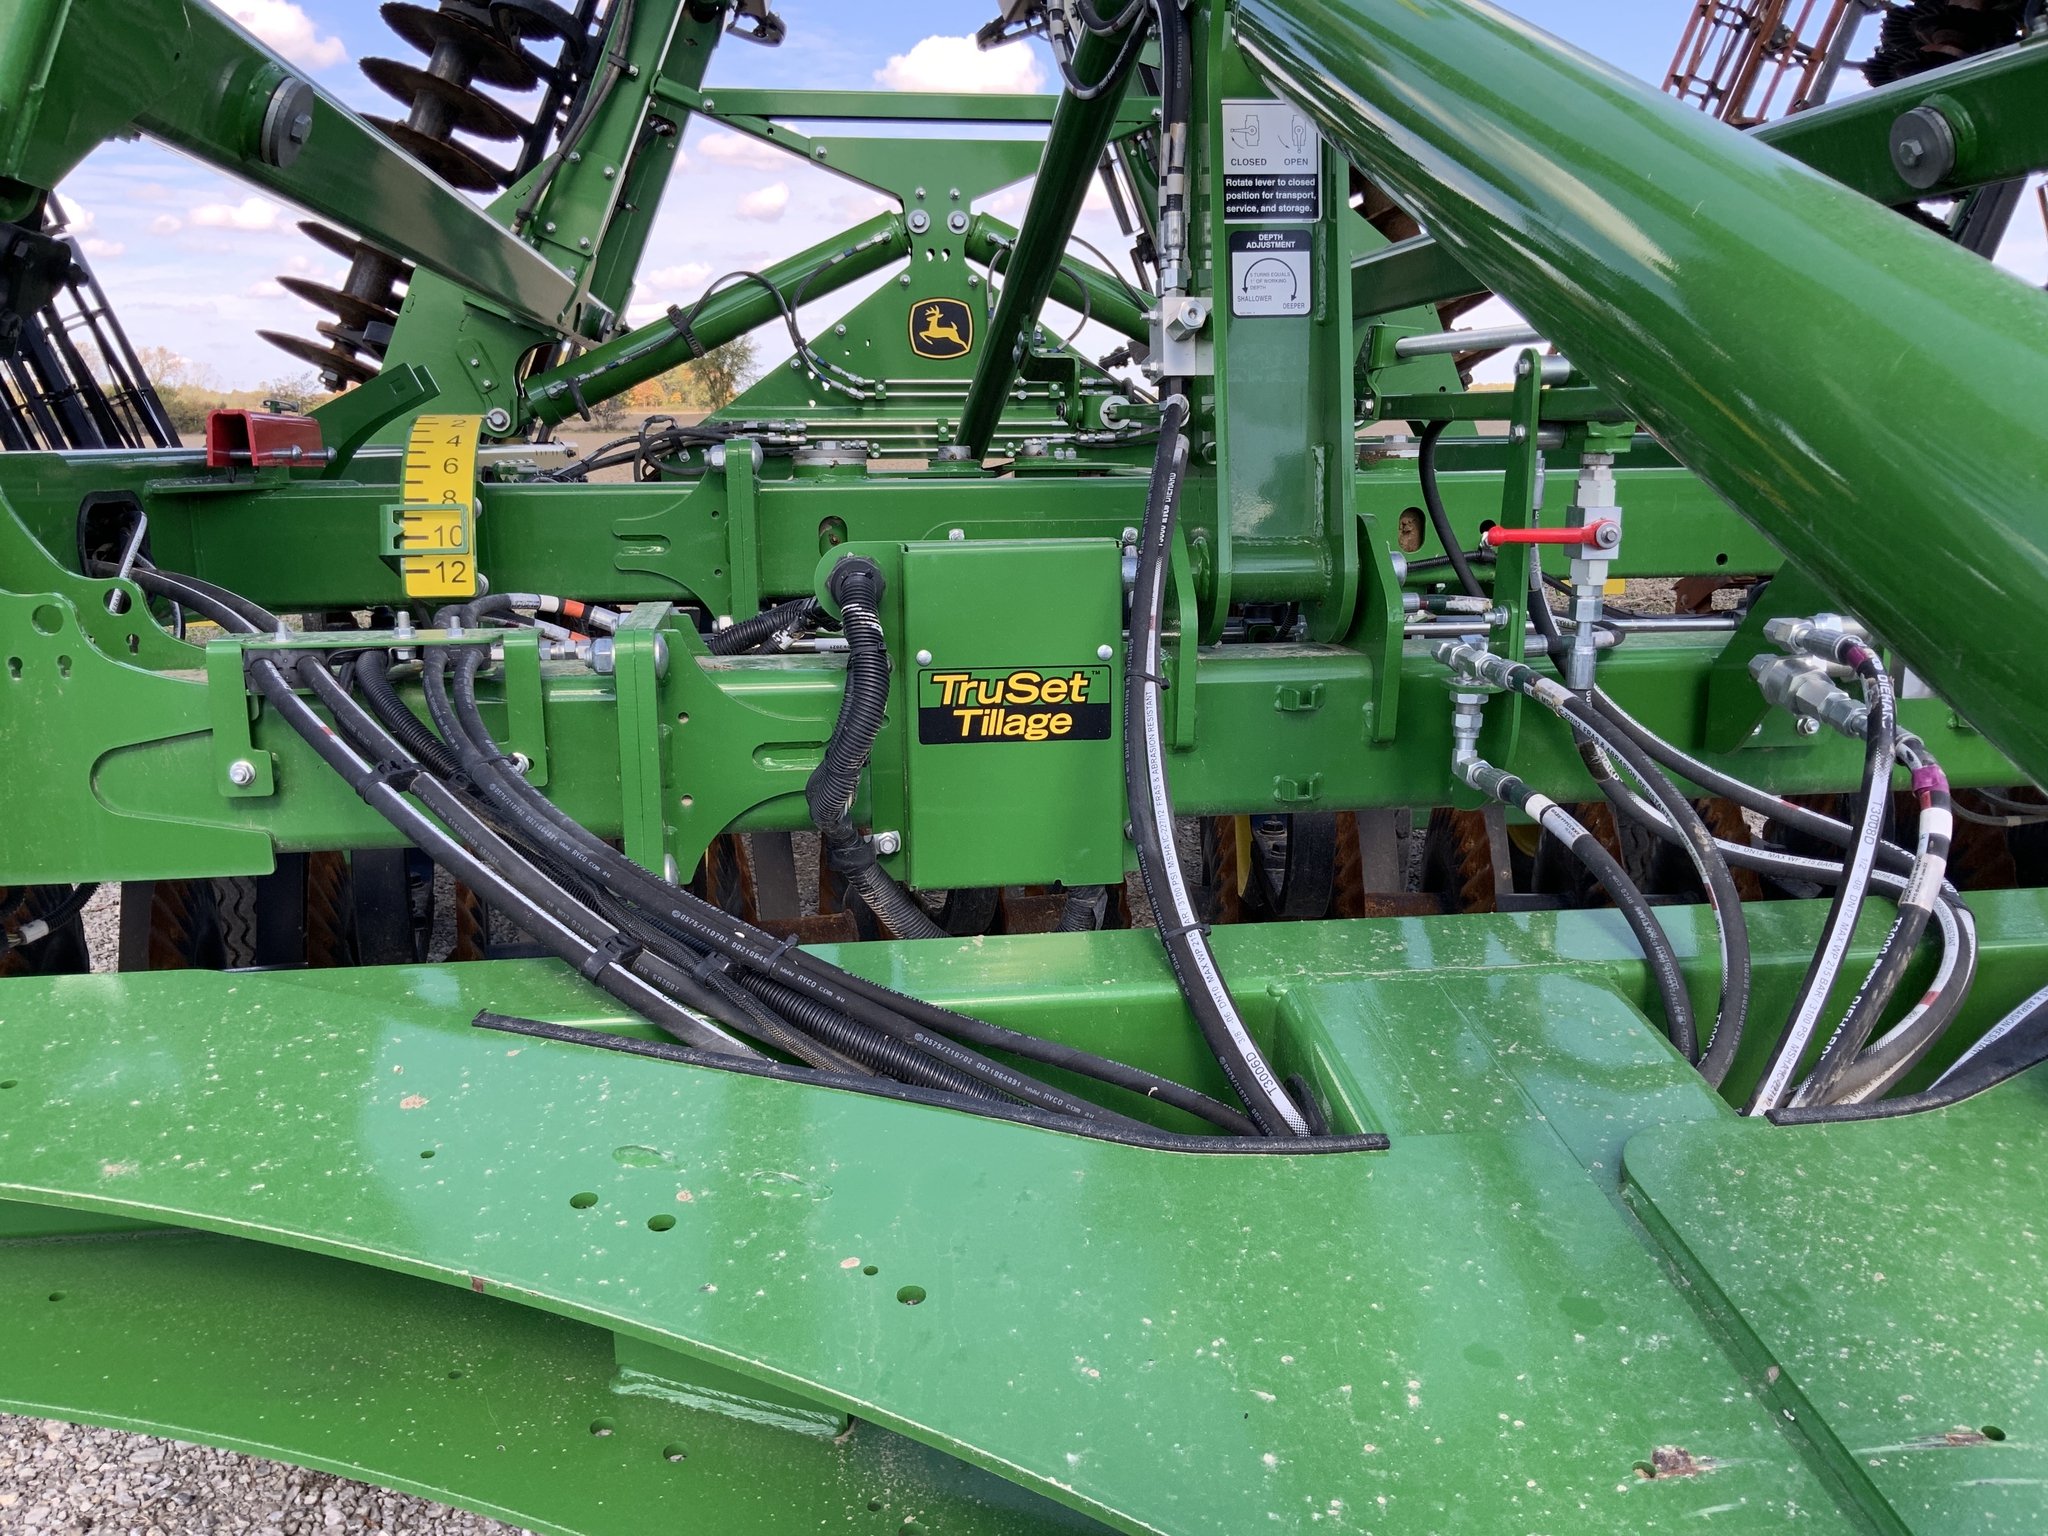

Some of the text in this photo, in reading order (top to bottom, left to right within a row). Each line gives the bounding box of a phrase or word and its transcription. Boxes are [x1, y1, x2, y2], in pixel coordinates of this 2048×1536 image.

[1230, 158, 1308, 166] CLOSED OPEN
[1226, 178, 1315, 187] Rotate lever to closed
[1226, 191, 1316, 202] position for transport,
[1226, 204, 1312, 214] service, and storage.
[450, 420, 466, 428] 2
[446, 435, 462, 447] 4
[443, 458, 459, 474] 6
[434, 525, 462, 547] 10
[436, 560, 467, 583] 12
[932, 672, 1089, 705] TruSet
[1145, 690, 1154, 732] RESISTANT
[952, 708, 1072, 741] Tillage
[1146, 733, 1160, 775] ABRASION
[1580, 725, 1600, 744] FRAS
[1604, 746, 1638, 780] ABRASION
[1636, 777, 1670, 820] RESISTANT
[1152, 783, 1163, 806] FRAS
[1862, 800, 1883, 845] T3008D
[570, 848, 588, 862] RYCO
[1162, 844, 1175, 868] MSHA
[1768, 852, 1785, 860] MAX
[1169, 870, 1179, 885] PSI
[1173, 886, 1185, 906] 3100
[1841, 893, 1859, 919] DN12
[570, 919, 589, 935] RYCO
[1180, 911, 1191, 925] AR
[1187, 930, 1200, 948] 215
[1833, 921, 1849, 944] MAX
[679, 912, 728, 944] 0575/210702
[797, 974, 817, 988] RYCO
[818, 985, 833, 996] com
[1194, 947, 1205, 963] WP
[1828, 943, 1841, 960] WP
[1200, 961, 1215, 983] MAX
[1822, 959, 1835, 976] 215
[650, 972, 680, 991] 200205
[1814, 977, 1827, 997] BAR
[1210, 984, 1227, 1008] DN10
[1801, 1003, 1816, 1025] 3100
[1794, 1024, 1807, 1041] PSI
[922, 1036, 973, 1065] 0575/210702
[1780, 1042, 1800, 1070] MSHA
[1244, 1049, 1278, 1096] T3006D
